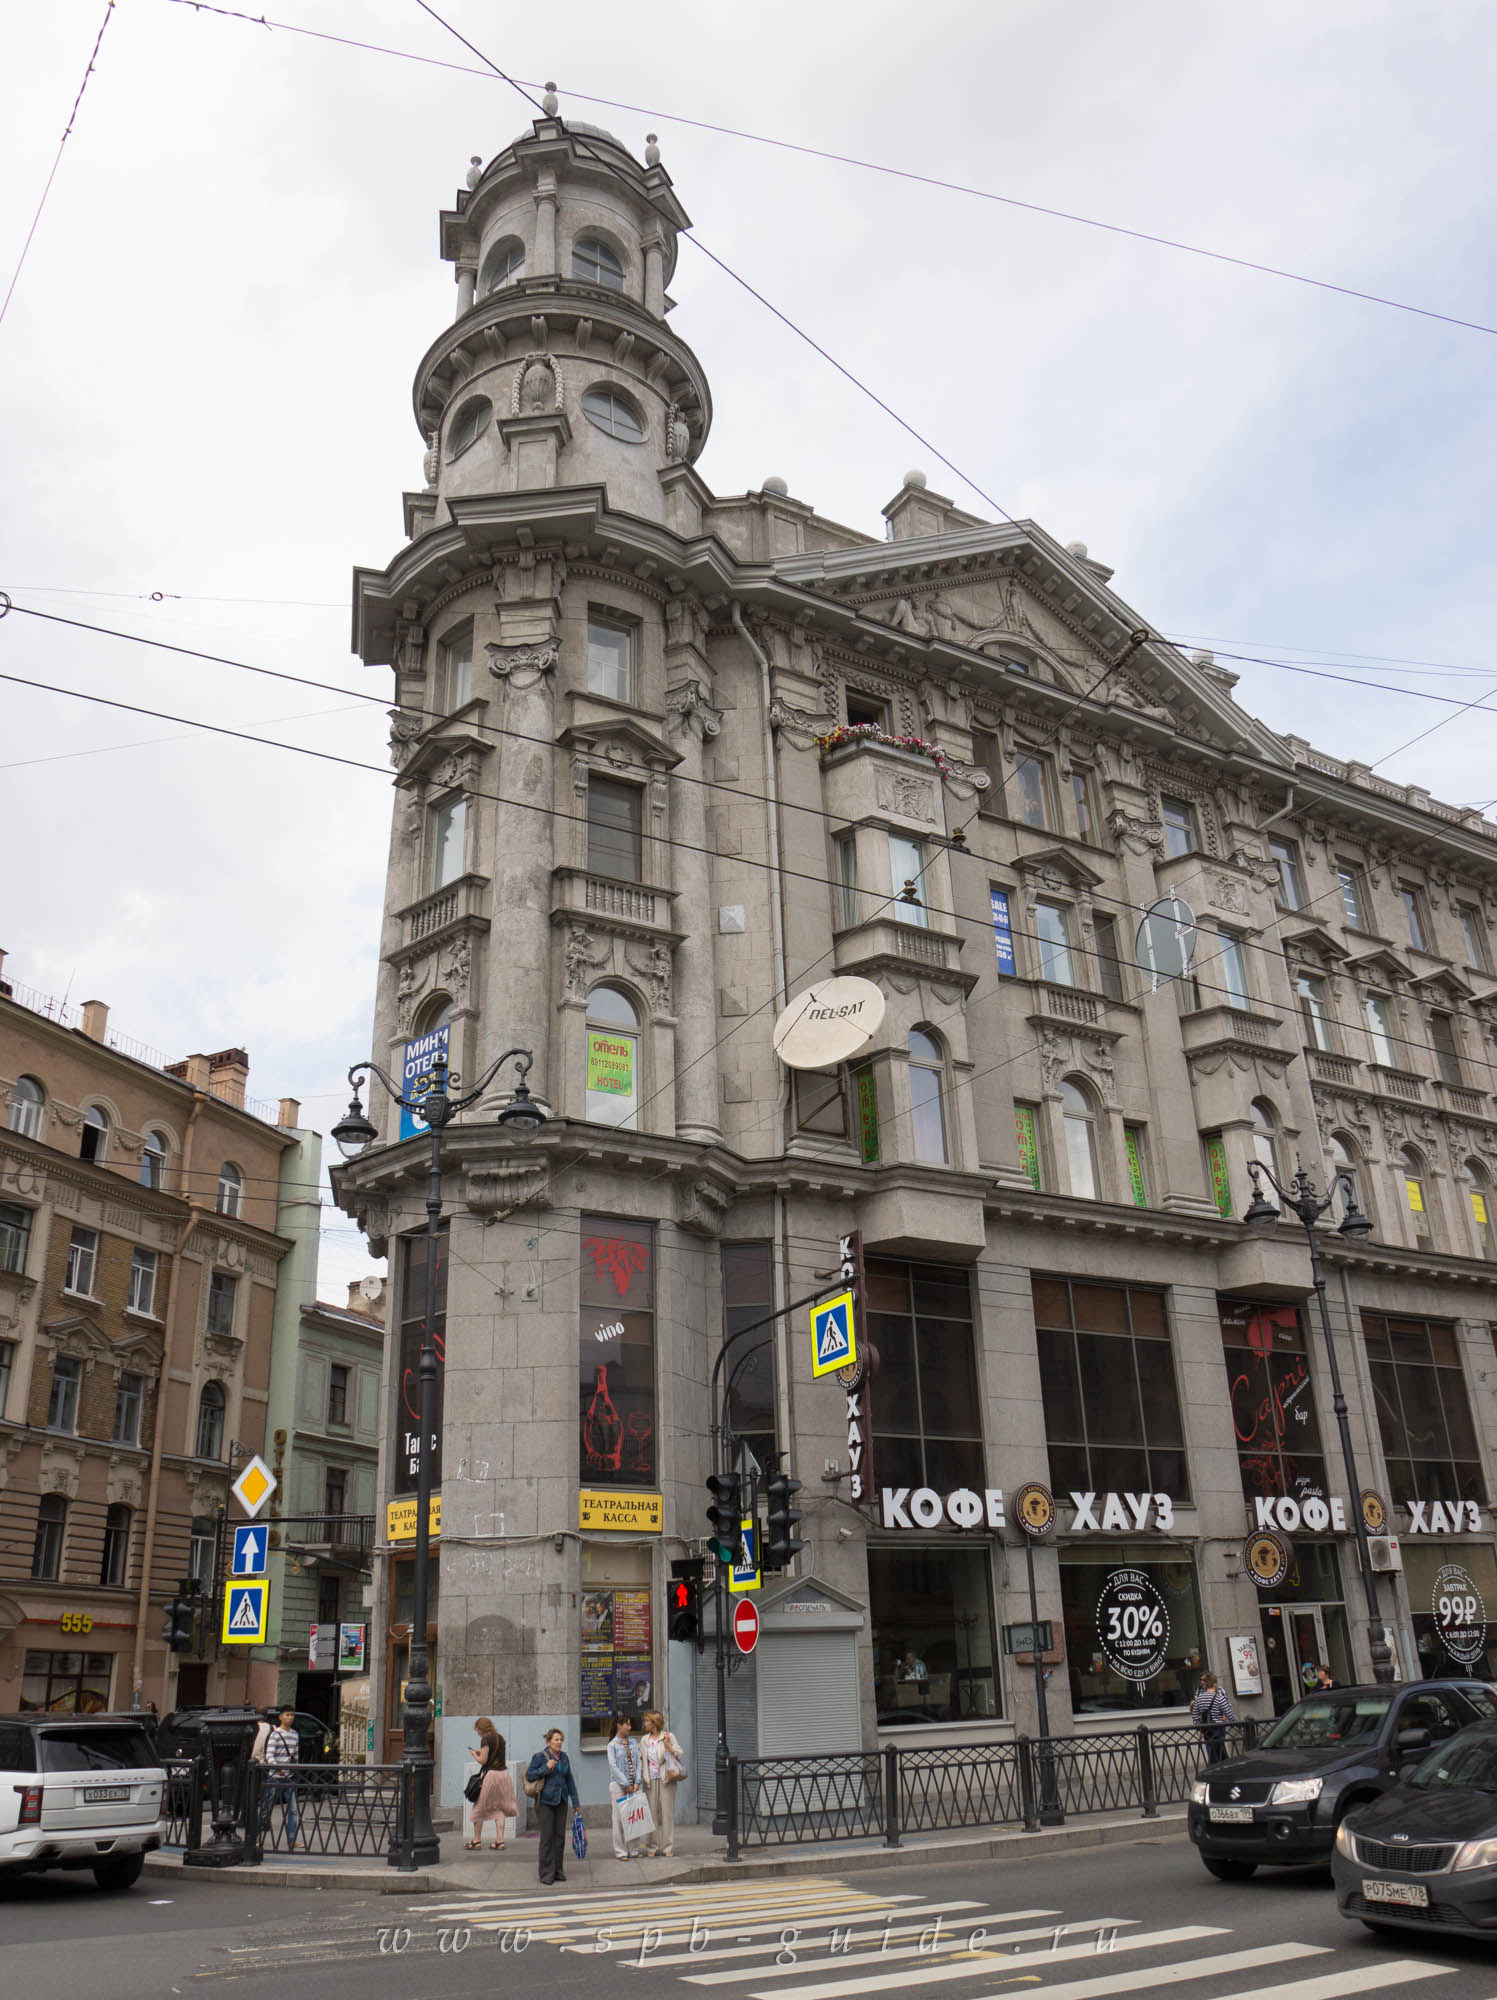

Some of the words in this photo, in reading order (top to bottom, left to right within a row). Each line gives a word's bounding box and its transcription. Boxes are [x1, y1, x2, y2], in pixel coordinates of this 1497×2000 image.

[596, 1075, 624, 1090] HOTEL
[594, 1321, 625, 1343] vino
[1231, 1356, 1307, 1442] Capri
[846, 1393, 862, 1499] ХАУЗ
[583, 1499, 659, 1511] ТЕАТРАЛЬНАЯ
[882, 1487, 1006, 1528] КОФЕ
[1069, 1492, 1175, 1530] ХАУЗ
[603, 1512, 638, 1523] КАССА
[1255, 1496, 1347, 1531] КОФЕ
[1407, 1500, 1482, 1533] ХАУЗ
[1113, 1573, 1129, 1586] ДЛЯ
[1130, 1573, 1144, 1584] ВАС
[1443, 1583, 1468, 1592] ЗАВТРАК
[1118, 1593, 1143, 1601] СКИДКА
[62, 1613, 93, 1632] 555
[1107, 1605, 1163, 1640] 30%
[1134, 1639, 1142, 1647] ДО
[1112, 1659, 1120, 1670] НА
[1121, 1666, 1134, 1677] ВСЮ
[1134, 1669, 1145, 1677] ЕДУ
